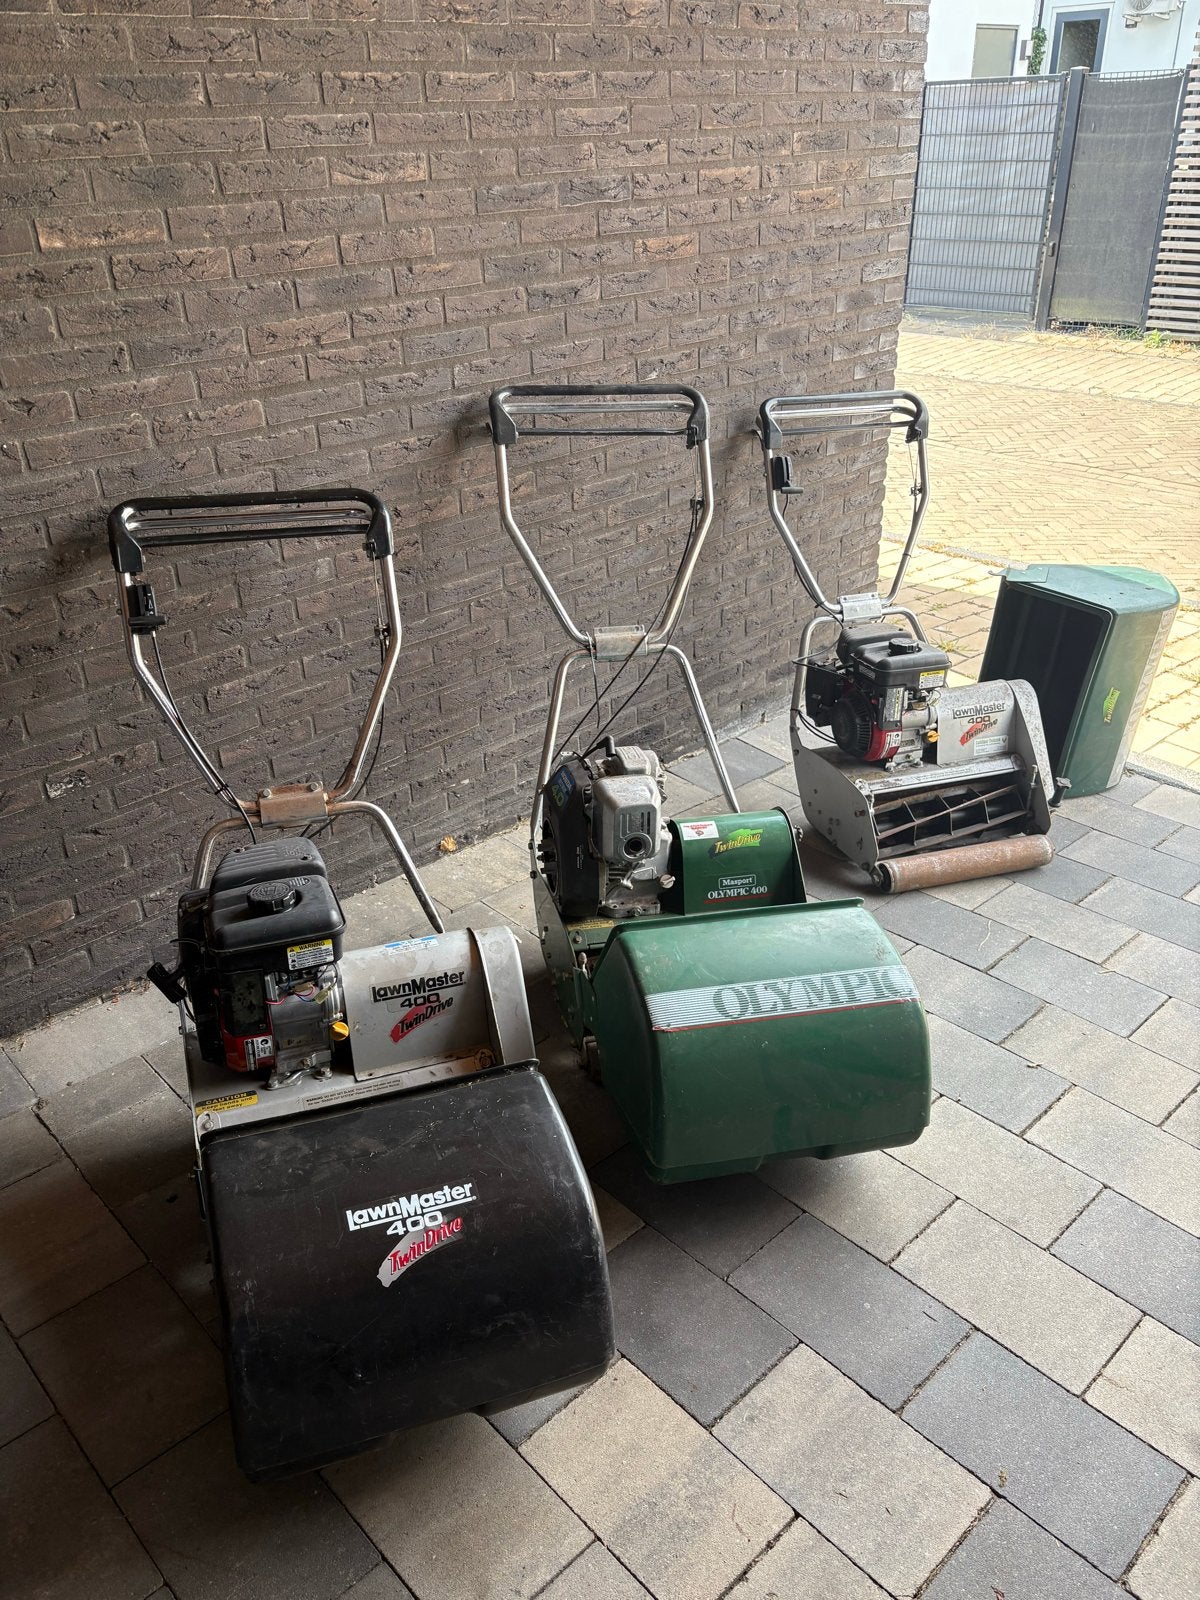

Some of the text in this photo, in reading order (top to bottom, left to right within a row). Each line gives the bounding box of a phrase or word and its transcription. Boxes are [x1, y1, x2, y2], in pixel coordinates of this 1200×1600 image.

[952, 702, 1006, 719] LawnMaster
[967, 715, 991, 724] 400
[965, 718, 999, 740] TwinDrive
[714, 833, 762, 854] TwinDrive
[722, 877, 753, 886] Masport
[707, 885, 768, 900] OLYMPIC 400
[298, 941, 326, 950] WARNING
[371, 971, 465, 1003] LawnMaster
[712, 968, 912, 1019] OLYMPIC
[400, 992, 441, 1009] 400
[398, 996, 454, 1034] TwinDrive
[205, 1092, 248, 1106] CAUTION
[345, 1182, 473, 1232] LawnMaster
[386, 1210, 444, 1236] 400
[388, 1216, 463, 1275] TwinDrive
